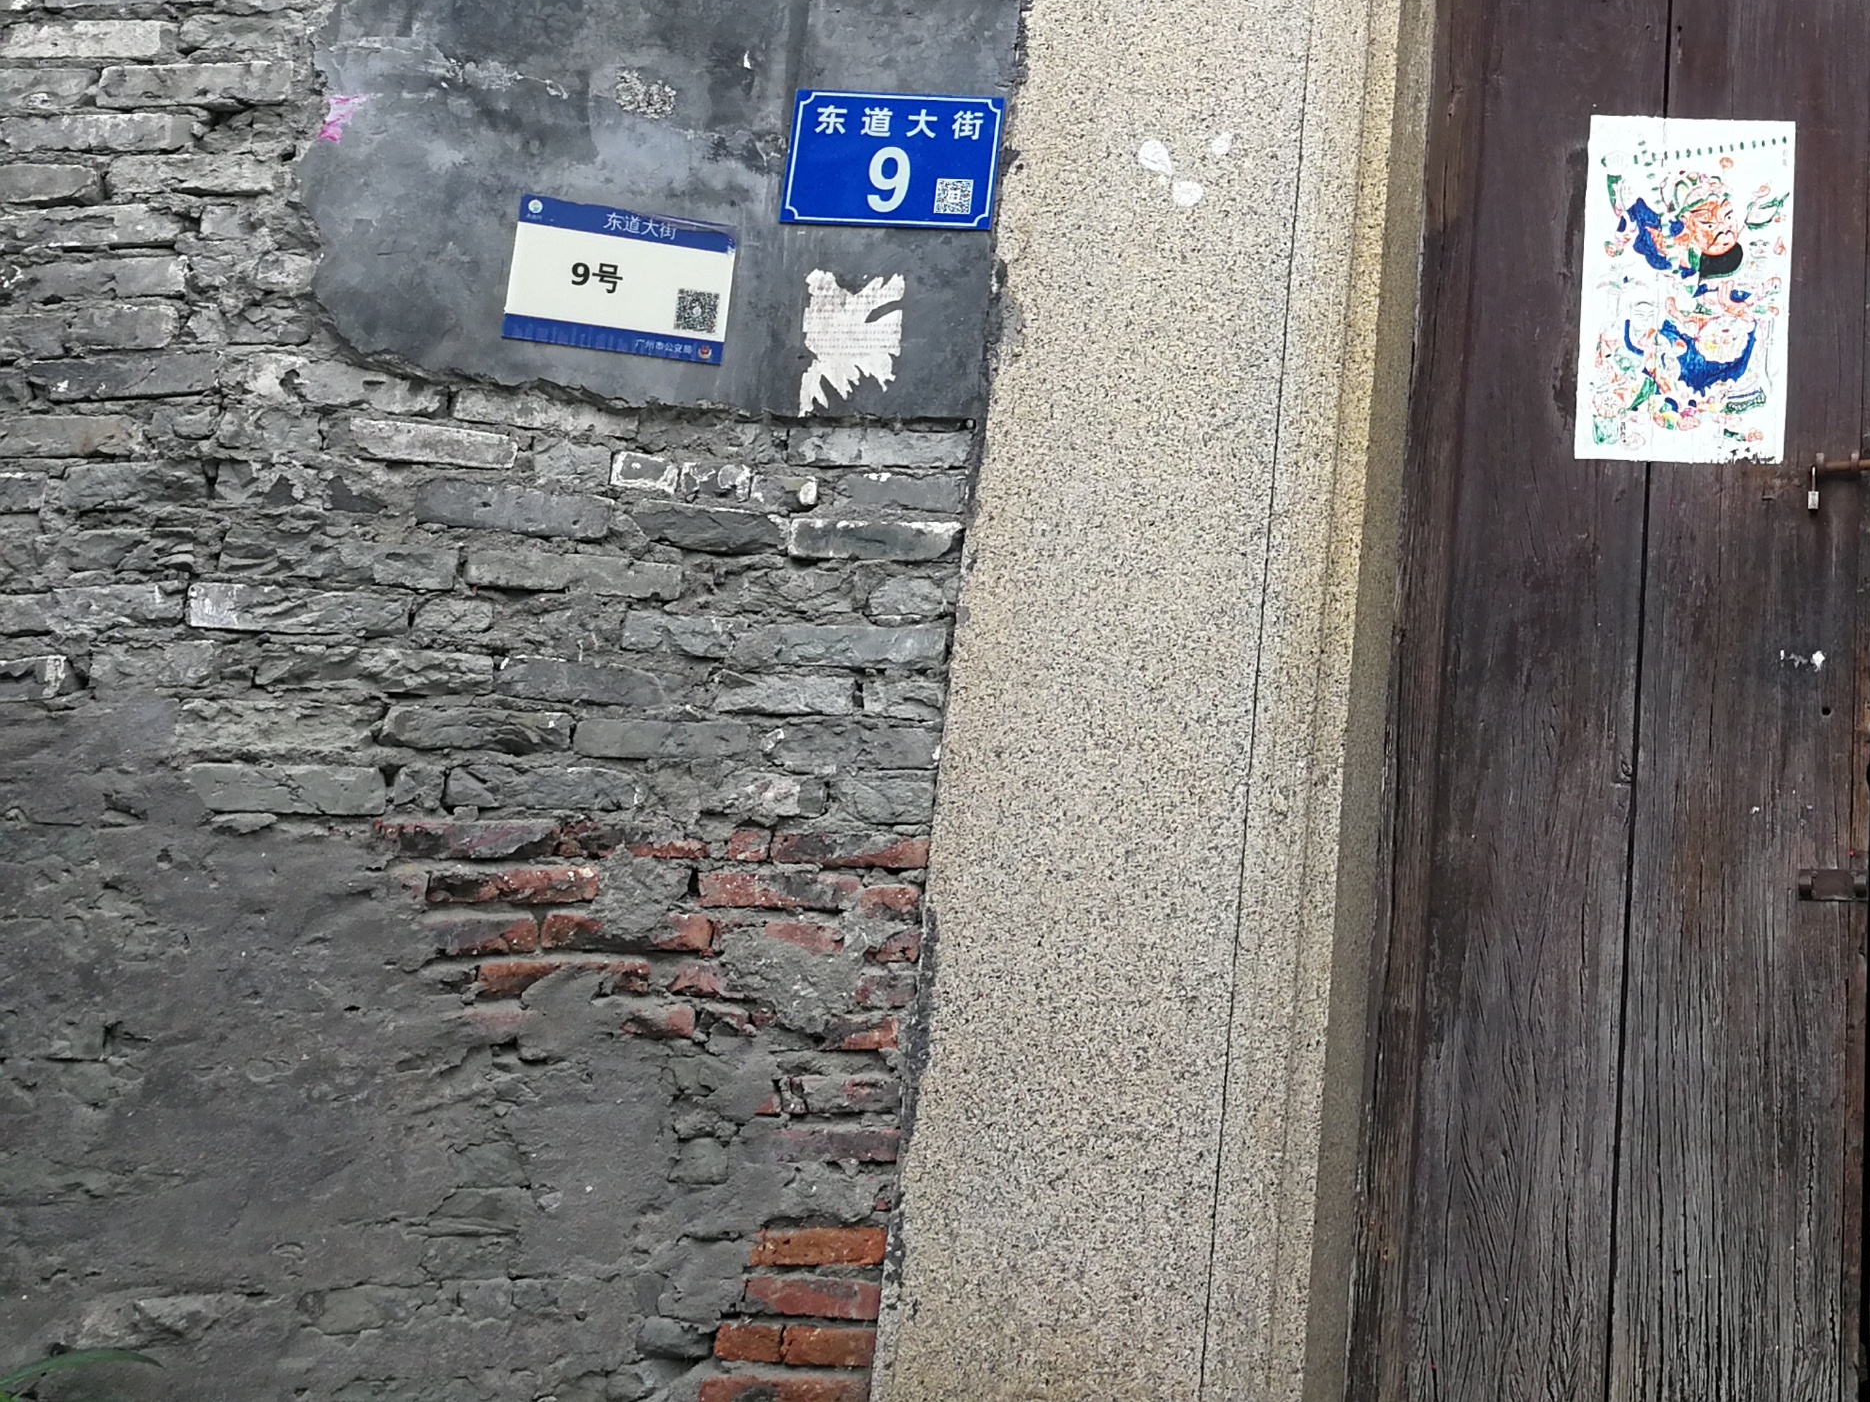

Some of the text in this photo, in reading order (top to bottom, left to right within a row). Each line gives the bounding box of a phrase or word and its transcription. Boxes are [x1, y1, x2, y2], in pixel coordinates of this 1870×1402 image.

[814, 104, 984, 140] 东道大街
[867, 147, 911, 212] 9
[603, 211, 676, 240] 东道大街
[571, 262, 623, 293] 9号
